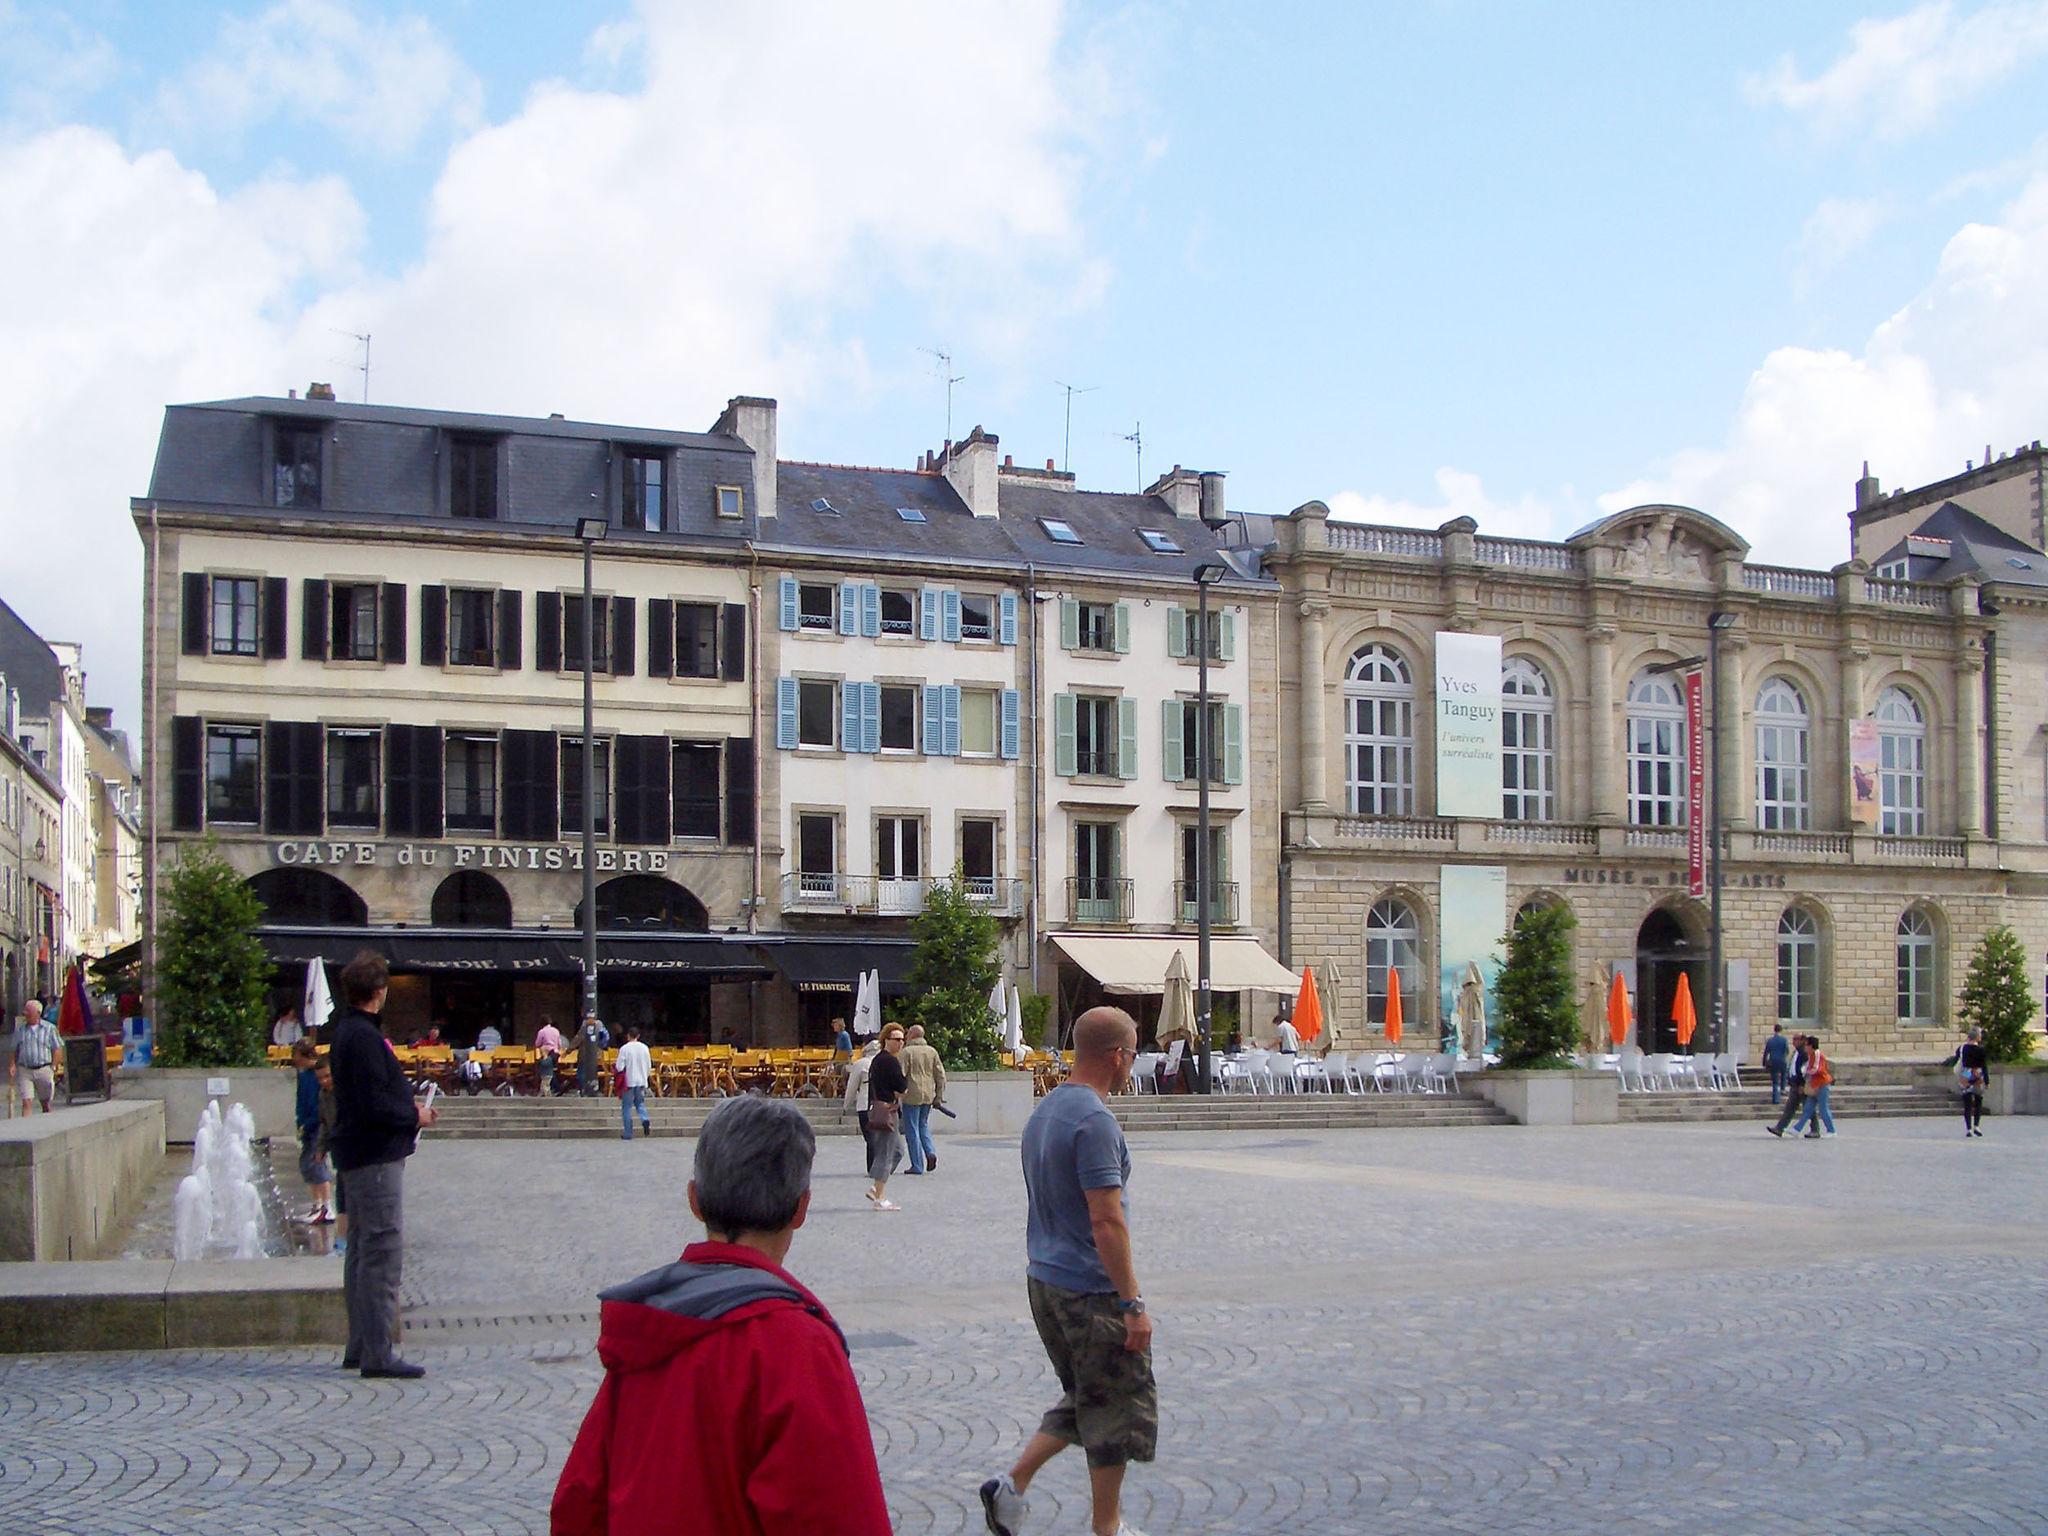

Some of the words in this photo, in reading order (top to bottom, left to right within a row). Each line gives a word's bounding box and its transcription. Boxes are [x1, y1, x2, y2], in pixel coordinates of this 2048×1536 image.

[1442, 676, 1478, 693] Yves
[1441, 699, 1497, 722] Tanguy
[277, 842, 376, 865] CAFE
[397, 844, 437, 865] du
